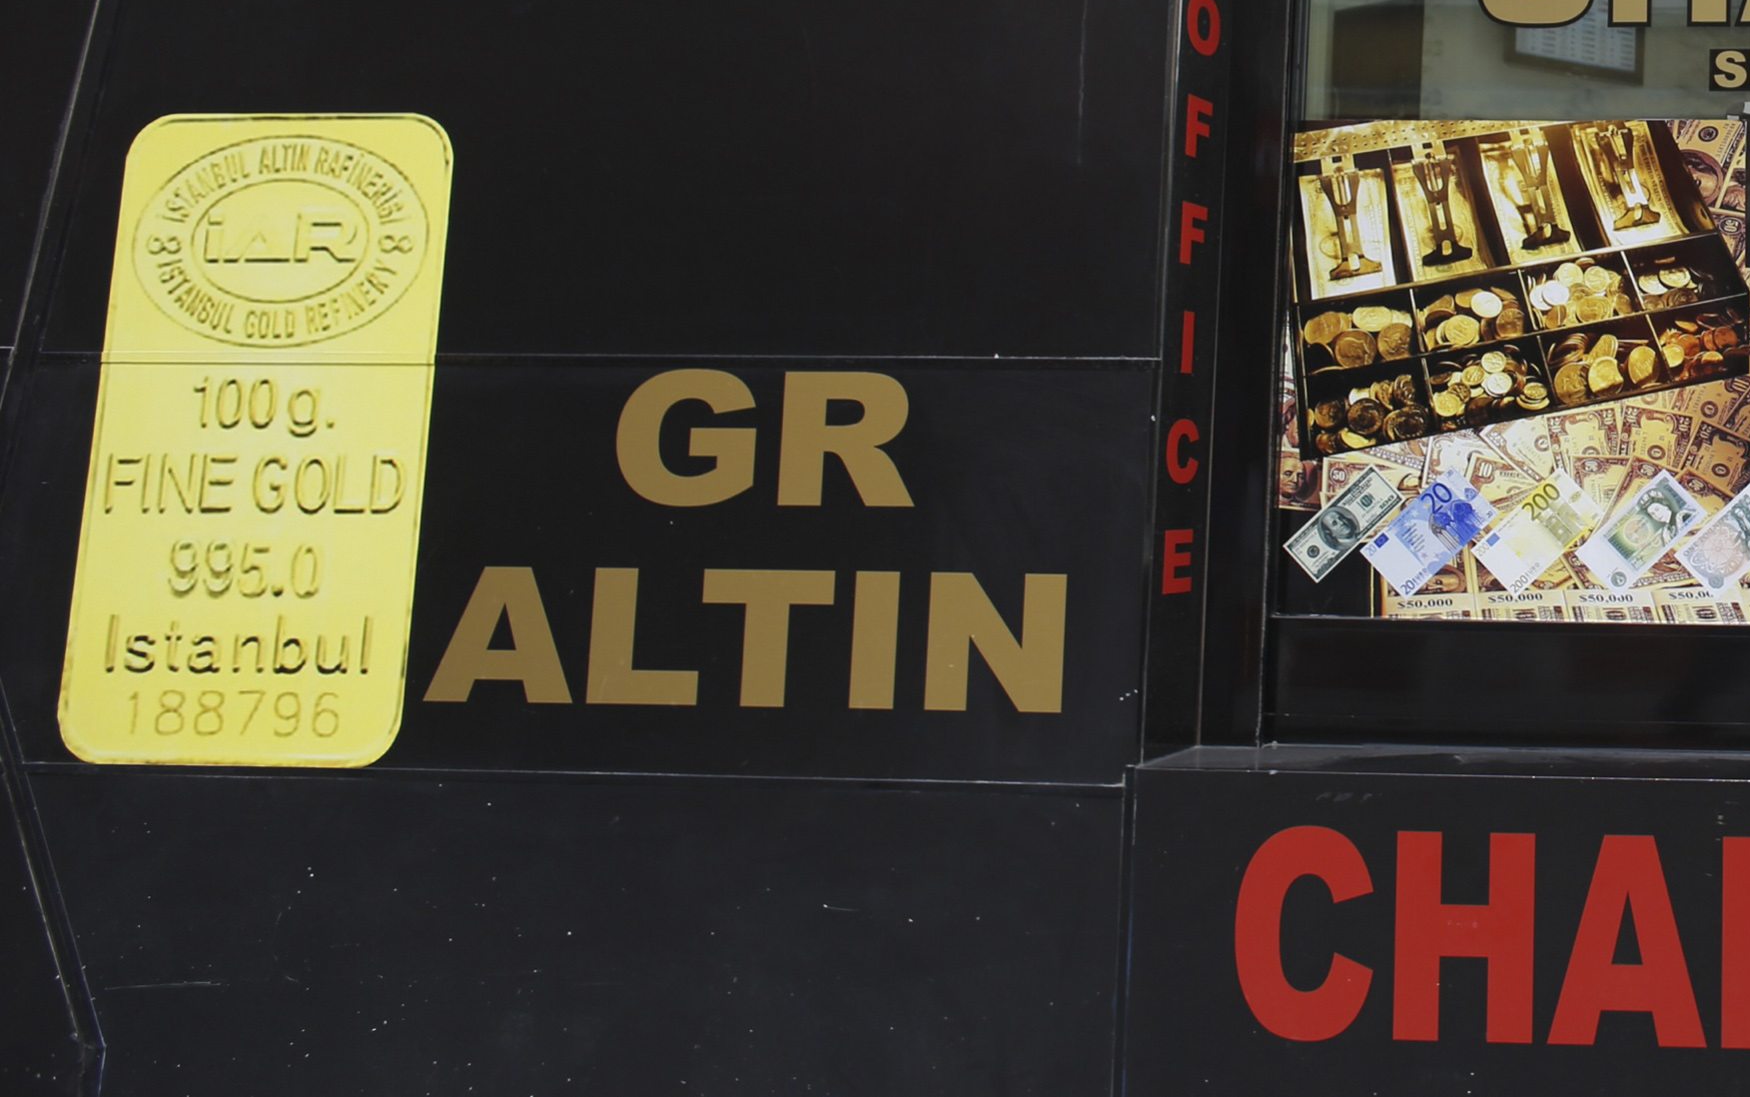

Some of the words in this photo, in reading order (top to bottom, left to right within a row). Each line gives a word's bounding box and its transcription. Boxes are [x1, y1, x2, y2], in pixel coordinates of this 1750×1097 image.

[244, 309, 296, 339] GOLD
[615, 367, 915, 508] GR
[103, 452, 239, 515] FINE
[251, 453, 407, 515] GOLD
[1420, 482, 1453, 515] 20
[1521, 482, 1561, 521] 200
[167, 538, 321, 600] 995.0
[1397, 598, 1453, 610] $50,000
[1488, 592, 1543, 604] $50,000
[104, 613, 374, 676] Istanbul
[422, 565, 1068, 714] ALTIN
[126, 688, 341, 739] 188796
